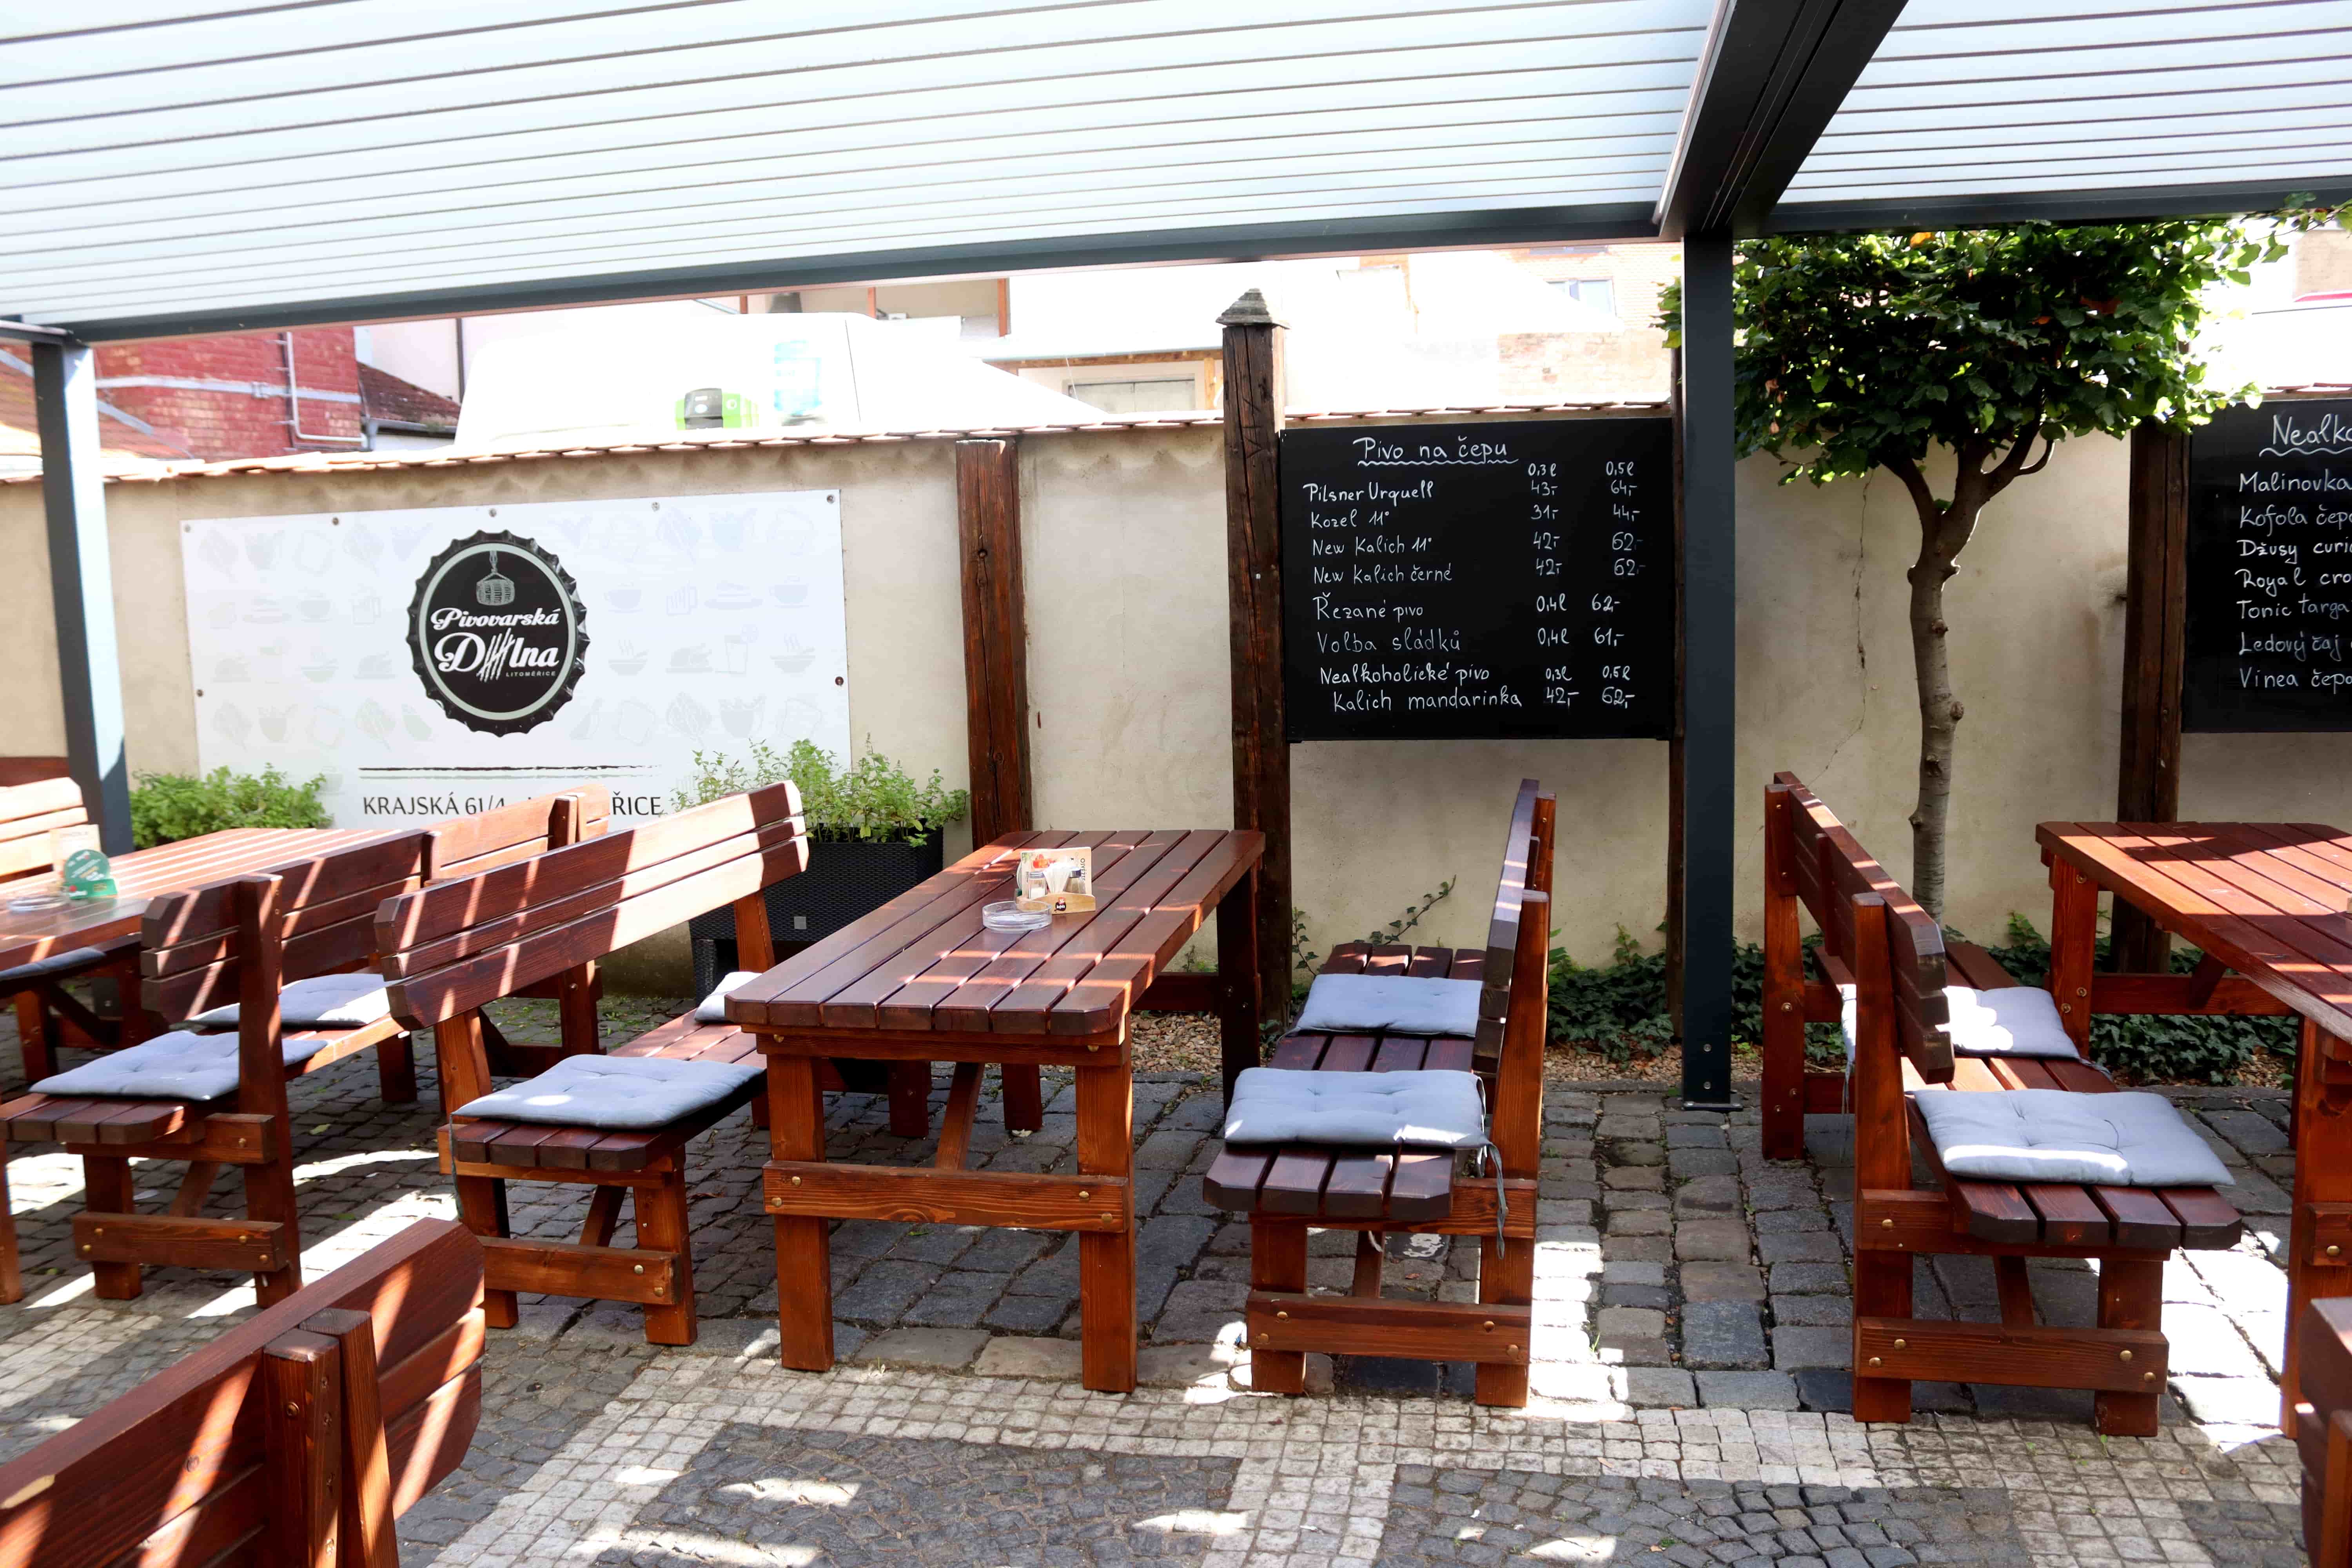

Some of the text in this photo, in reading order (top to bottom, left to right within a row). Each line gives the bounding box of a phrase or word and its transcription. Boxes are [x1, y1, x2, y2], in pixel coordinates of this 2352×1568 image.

[1352, 435, 1507, 463] Pivo na čepu
[1302, 483, 1365, 502] Pilsner
[1368, 479, 1434, 507] Urquell
[2239, 468, 2352, 493] Malinovka
[1311, 508, 1357, 529] Kozel
[1368, 510, 1390, 526] 11°
[2239, 504, 2308, 537] Kofola
[1313, 539, 1345, 555] New
[1355, 534, 1405, 556] Kalich
[1411, 537, 1432, 552] 11°
[2236, 539, 2298, 564] Džusy
[1314, 566, 1344, 584] New
[1354, 564, 1404, 584] Kalich
[1410, 563, 1452, 582] černé
[430, 607, 561, 630] Pivovarská
[1312, 592, 1386, 620] Řezané
[1393, 606, 1423, 623] pivo
[2236, 593, 2350, 619] Tonic targa
[1317, 631, 1377, 653] Volba
[1392, 627, 1460, 652] sládků
[2239, 631, 2341, 662] Ledový čaj
[1320, 662, 1450, 685] Nealkoholické
[1455, 664, 1490, 686] pivo
[2239, 667, 2299, 688] Vinea
[1334, 689, 1391, 712] Kalich
[1408, 685, 1522, 710] mandarinka
[363, 791, 459, 815] KRAJSKÁ
